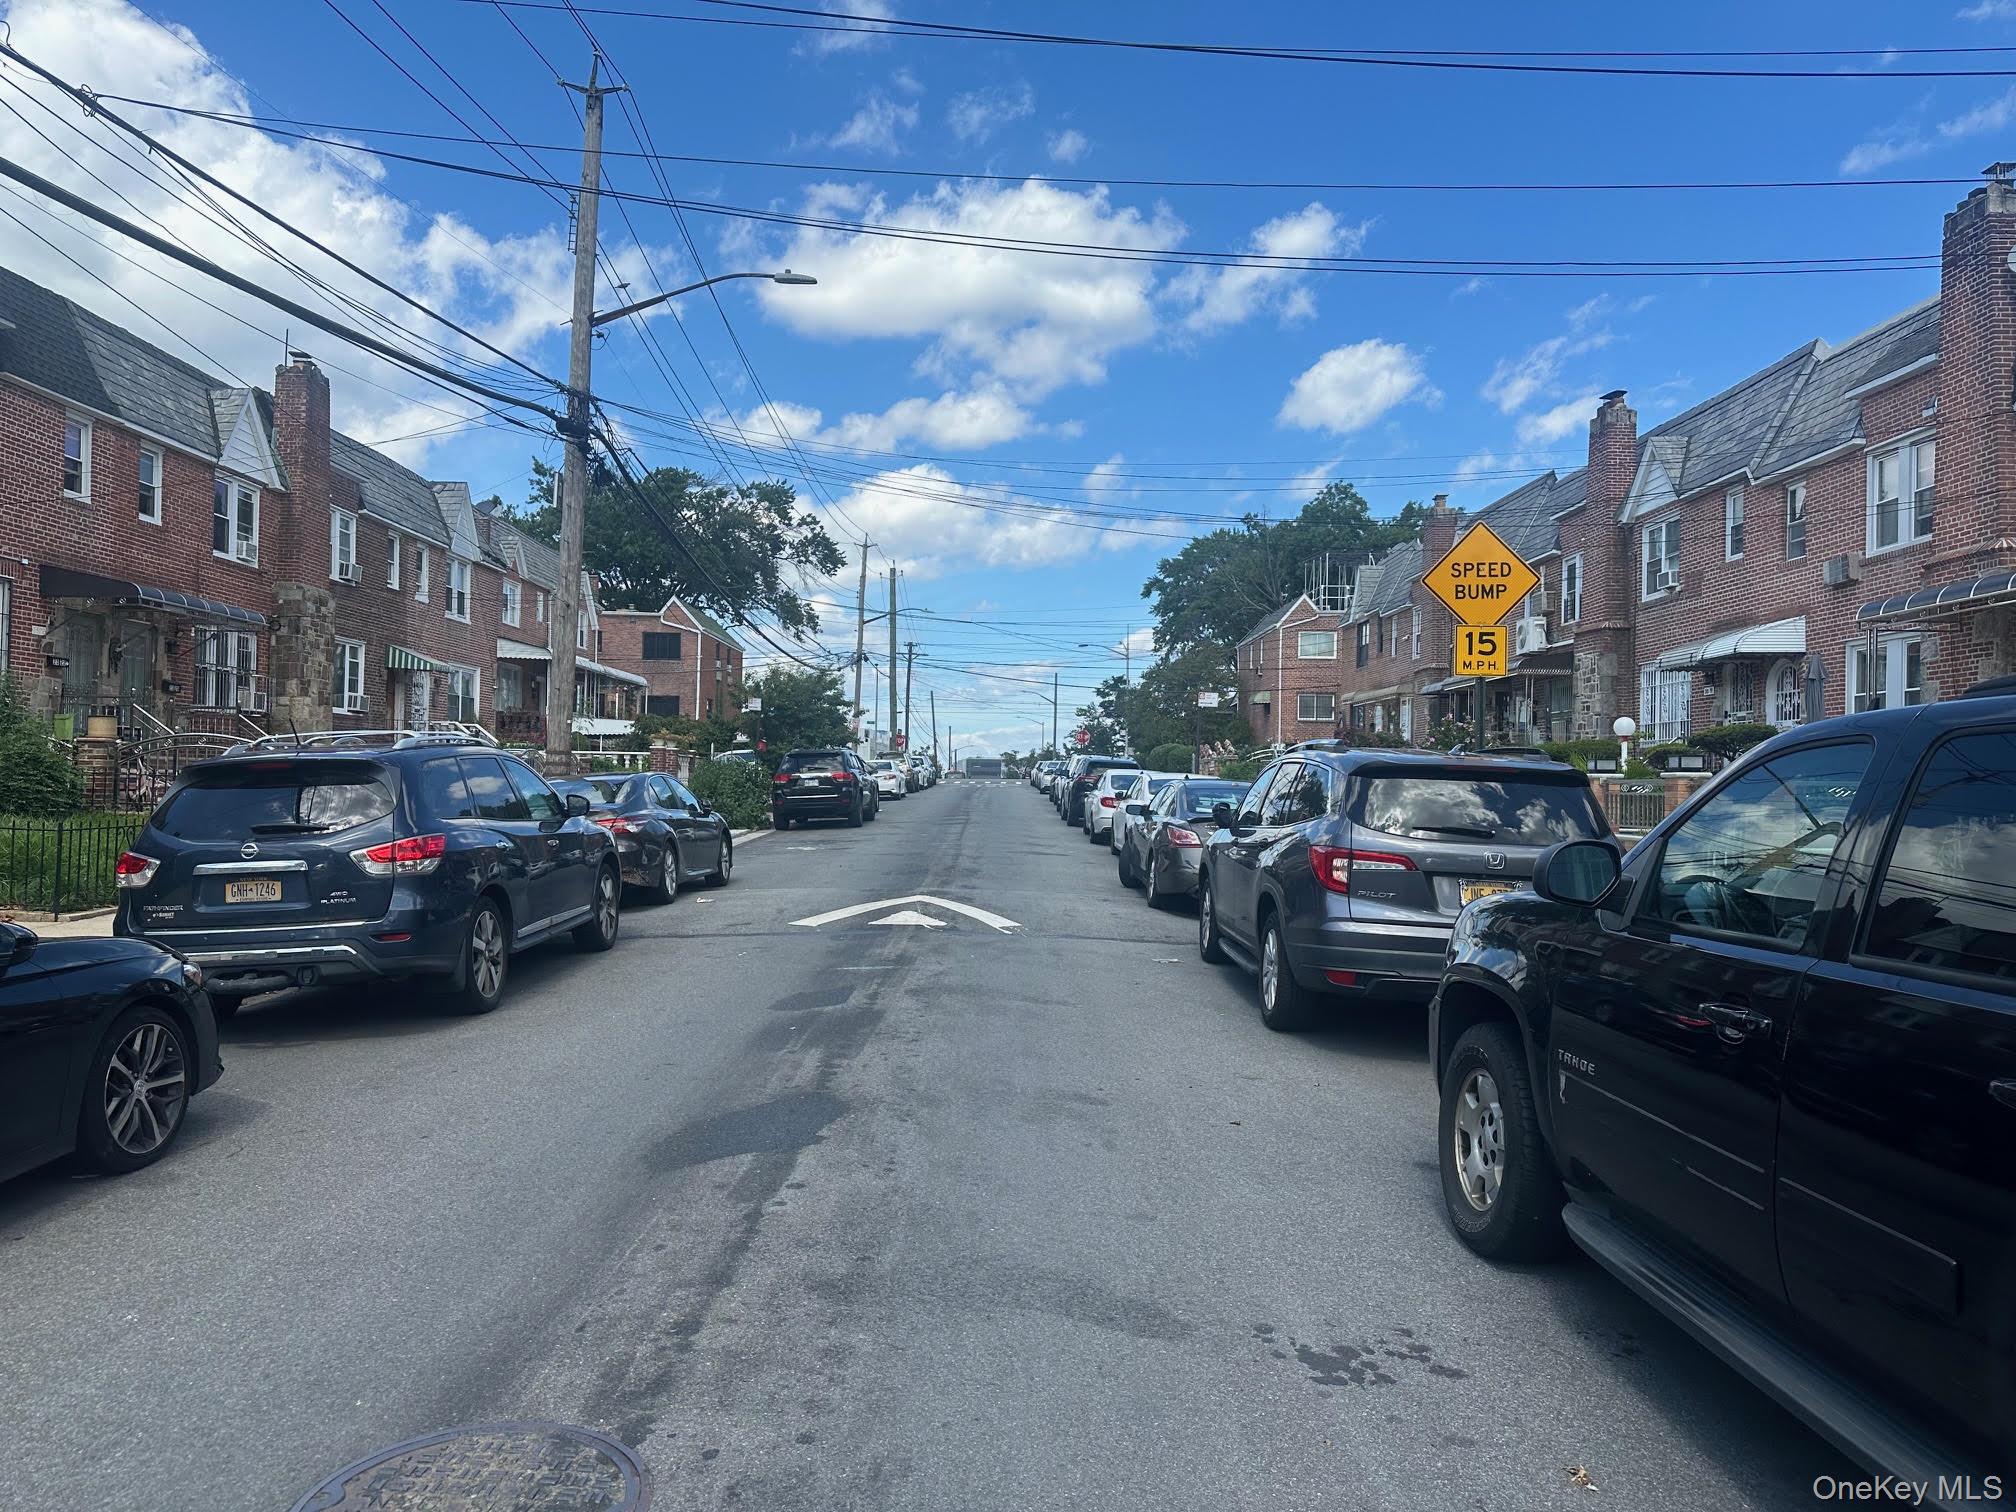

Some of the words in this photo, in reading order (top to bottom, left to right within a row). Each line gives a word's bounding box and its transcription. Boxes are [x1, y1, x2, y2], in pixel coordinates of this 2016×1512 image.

[1450, 562, 1512, 578] SPEED
[1454, 584, 1508, 600] BUMP
[1465, 631, 1498, 656] 15
[1357, 890, 1397, 898] PILOT
[1558, 1049, 1596, 1076] TAHOE
